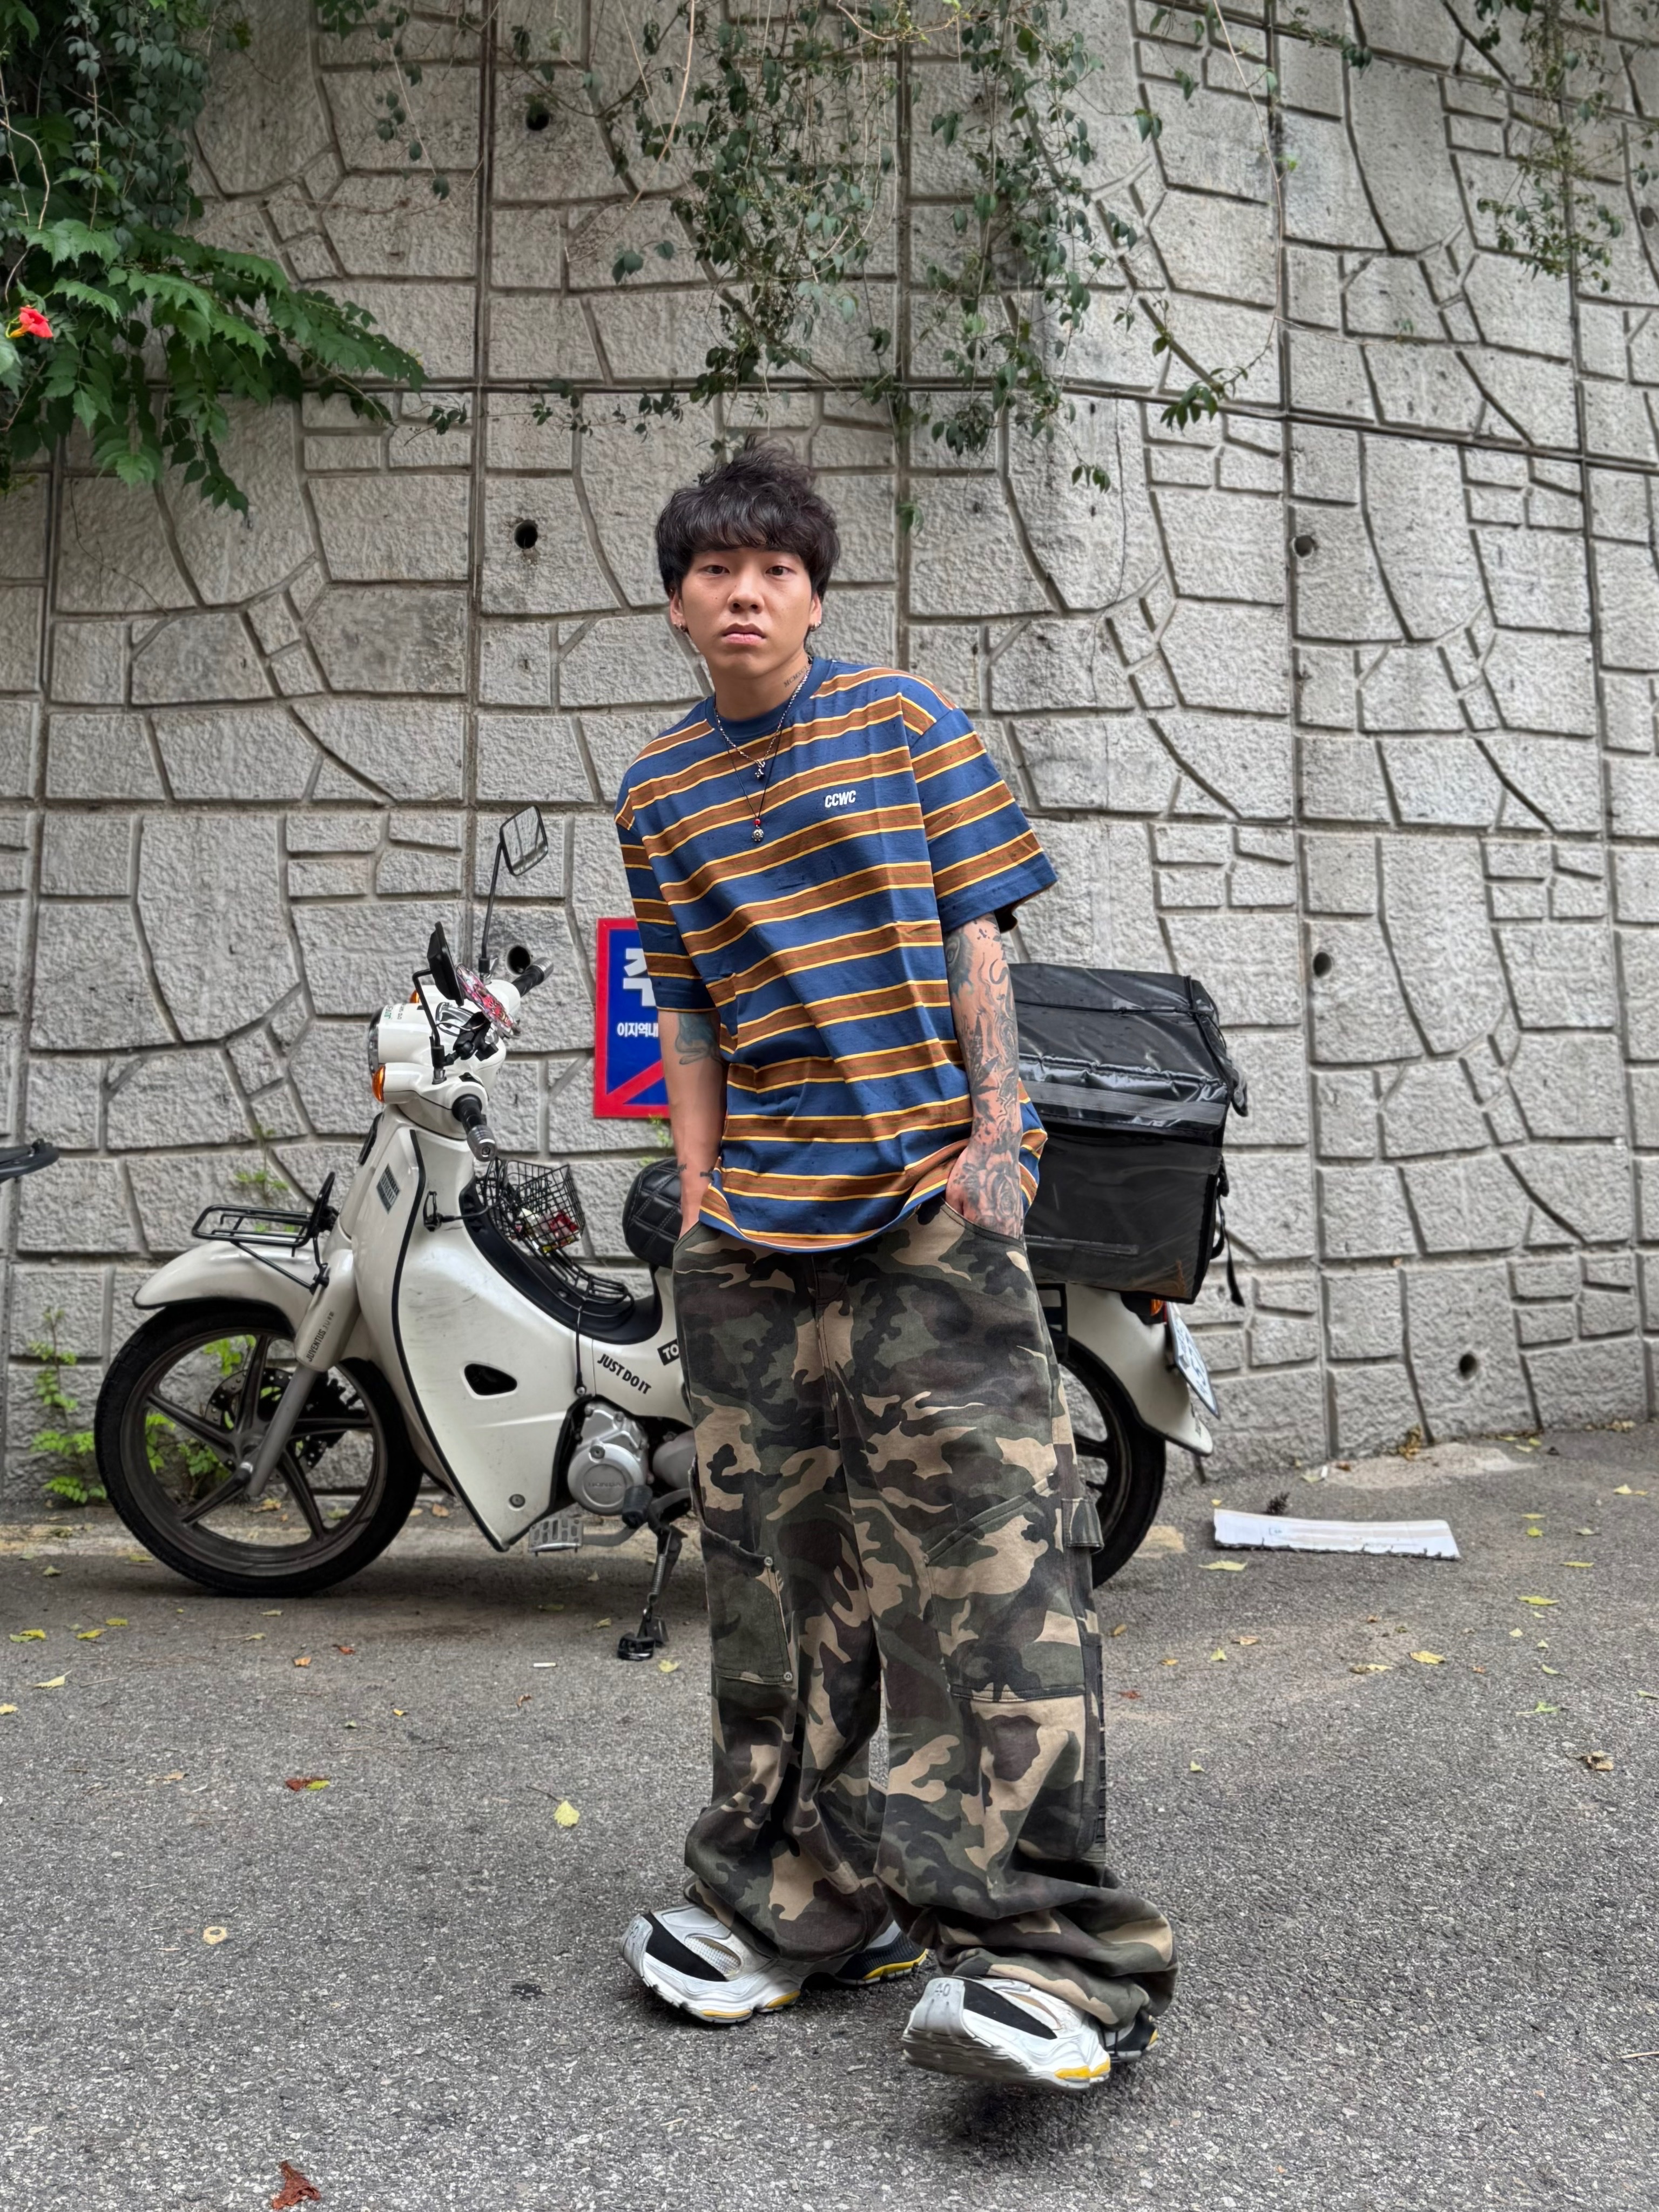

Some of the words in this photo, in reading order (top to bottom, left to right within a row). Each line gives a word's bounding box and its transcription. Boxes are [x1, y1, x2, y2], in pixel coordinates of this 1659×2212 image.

[825, 790, 857, 808] CCWC
[306, 1328, 326, 1362] JUVENTUS
[597, 1353, 625, 1376] JUST
[622, 1370, 639, 1387] DO
[638, 1380, 652, 1394] IT
[935, 1983, 951, 1997] 40
